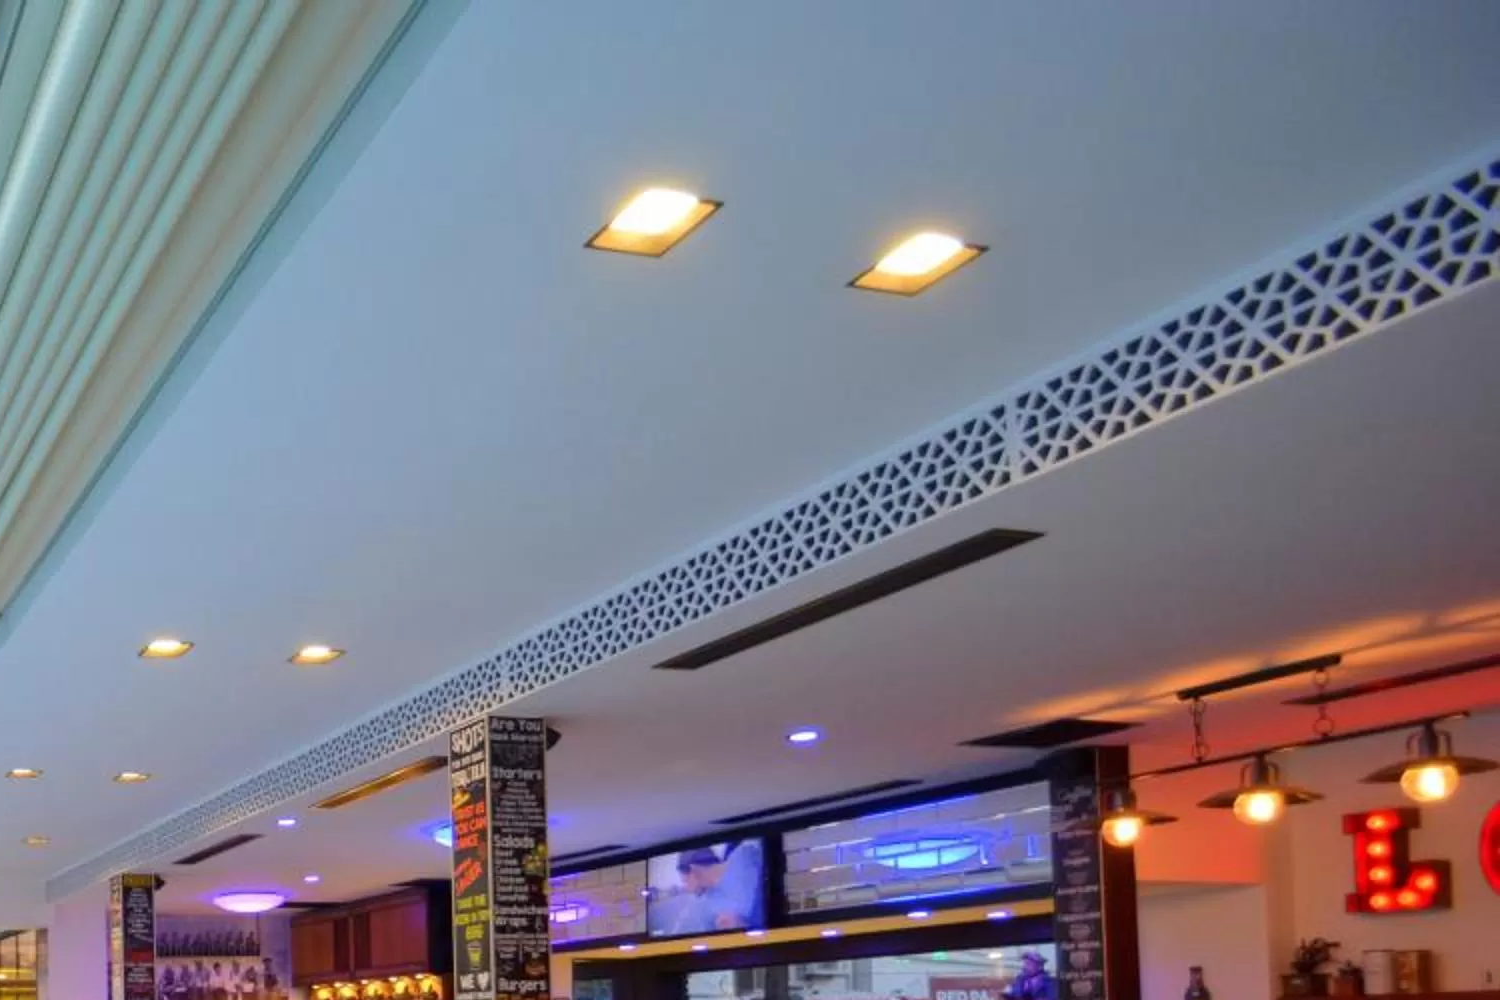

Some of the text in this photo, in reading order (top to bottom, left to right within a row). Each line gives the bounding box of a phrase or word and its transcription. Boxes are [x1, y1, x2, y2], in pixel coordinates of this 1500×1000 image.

[491, 718, 542, 732] Are You
[451, 723, 485, 755] SHOTS
[491, 768, 543, 780] Starters
[493, 834, 535, 849] Salads
[498, 978, 547, 994] Burgers
